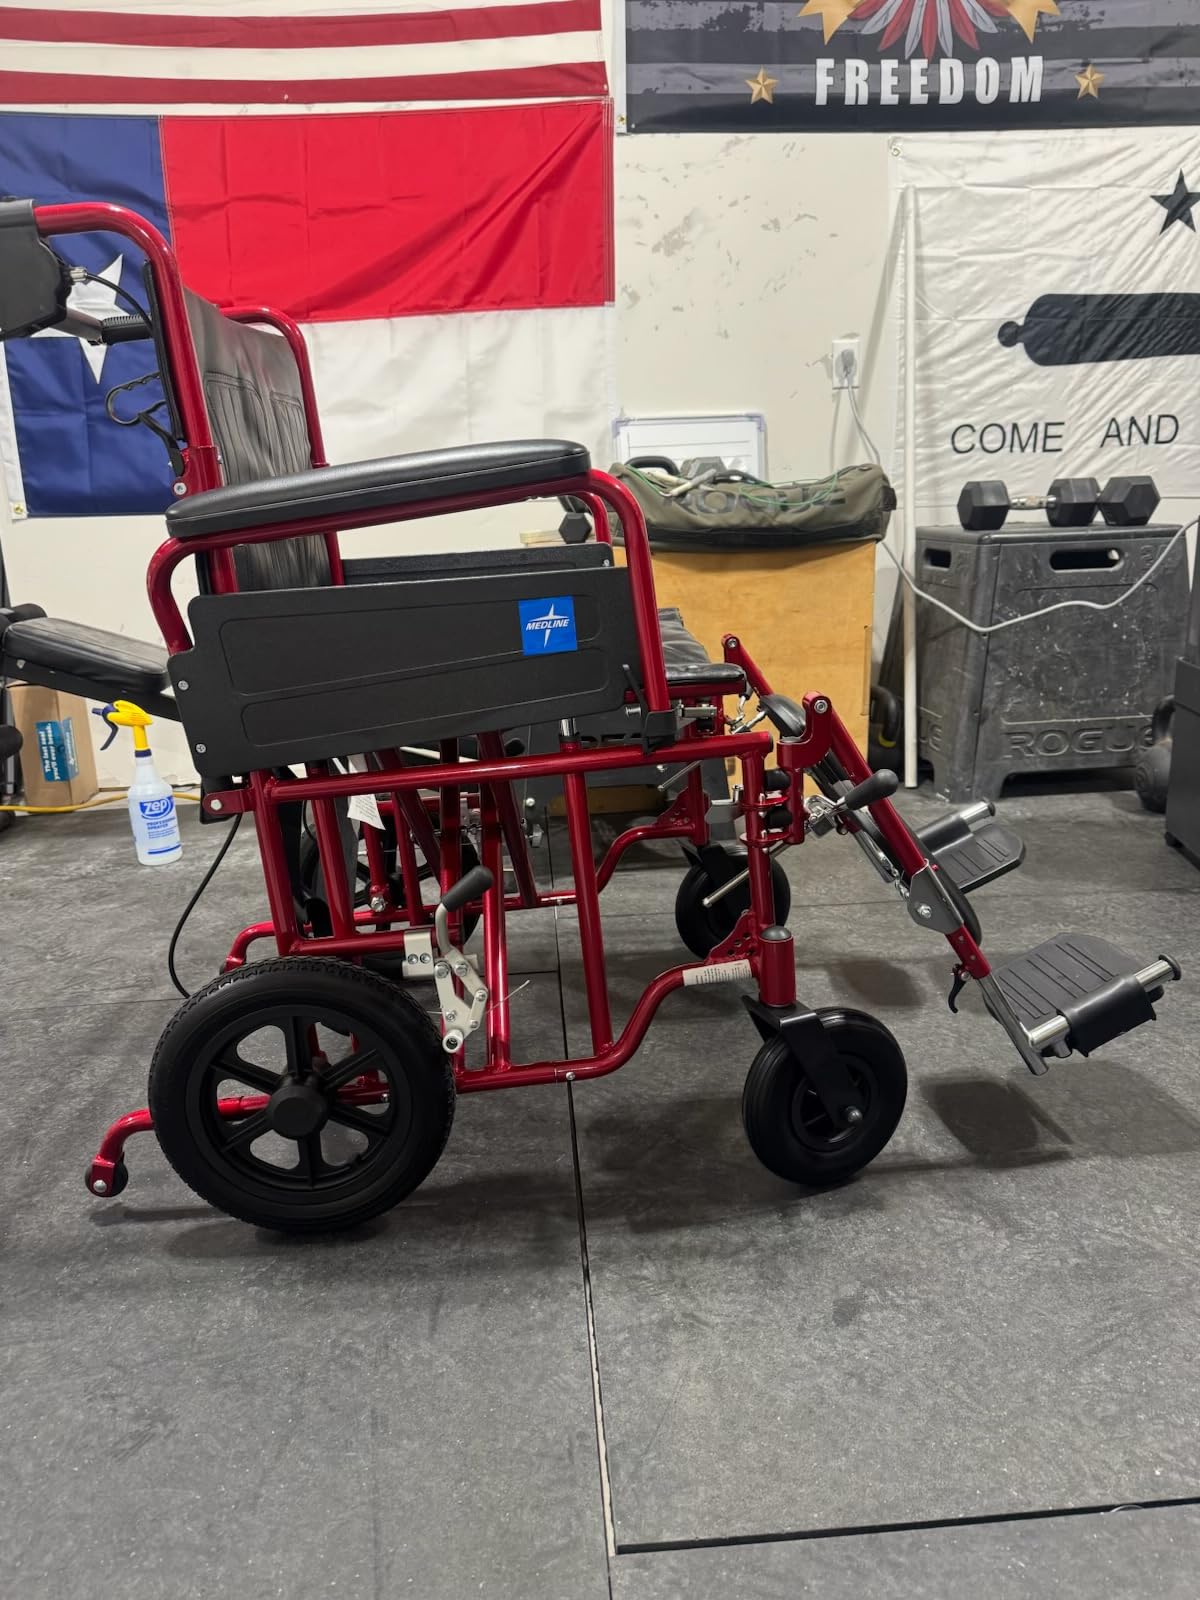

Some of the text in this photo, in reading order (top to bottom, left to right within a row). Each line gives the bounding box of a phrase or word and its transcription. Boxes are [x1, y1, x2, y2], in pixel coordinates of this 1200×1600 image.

[815, 55, 1043, 105] FREEDOM
[951, 414, 1179, 454] COME AND
[526, 619, 570, 631] MEDLINE
